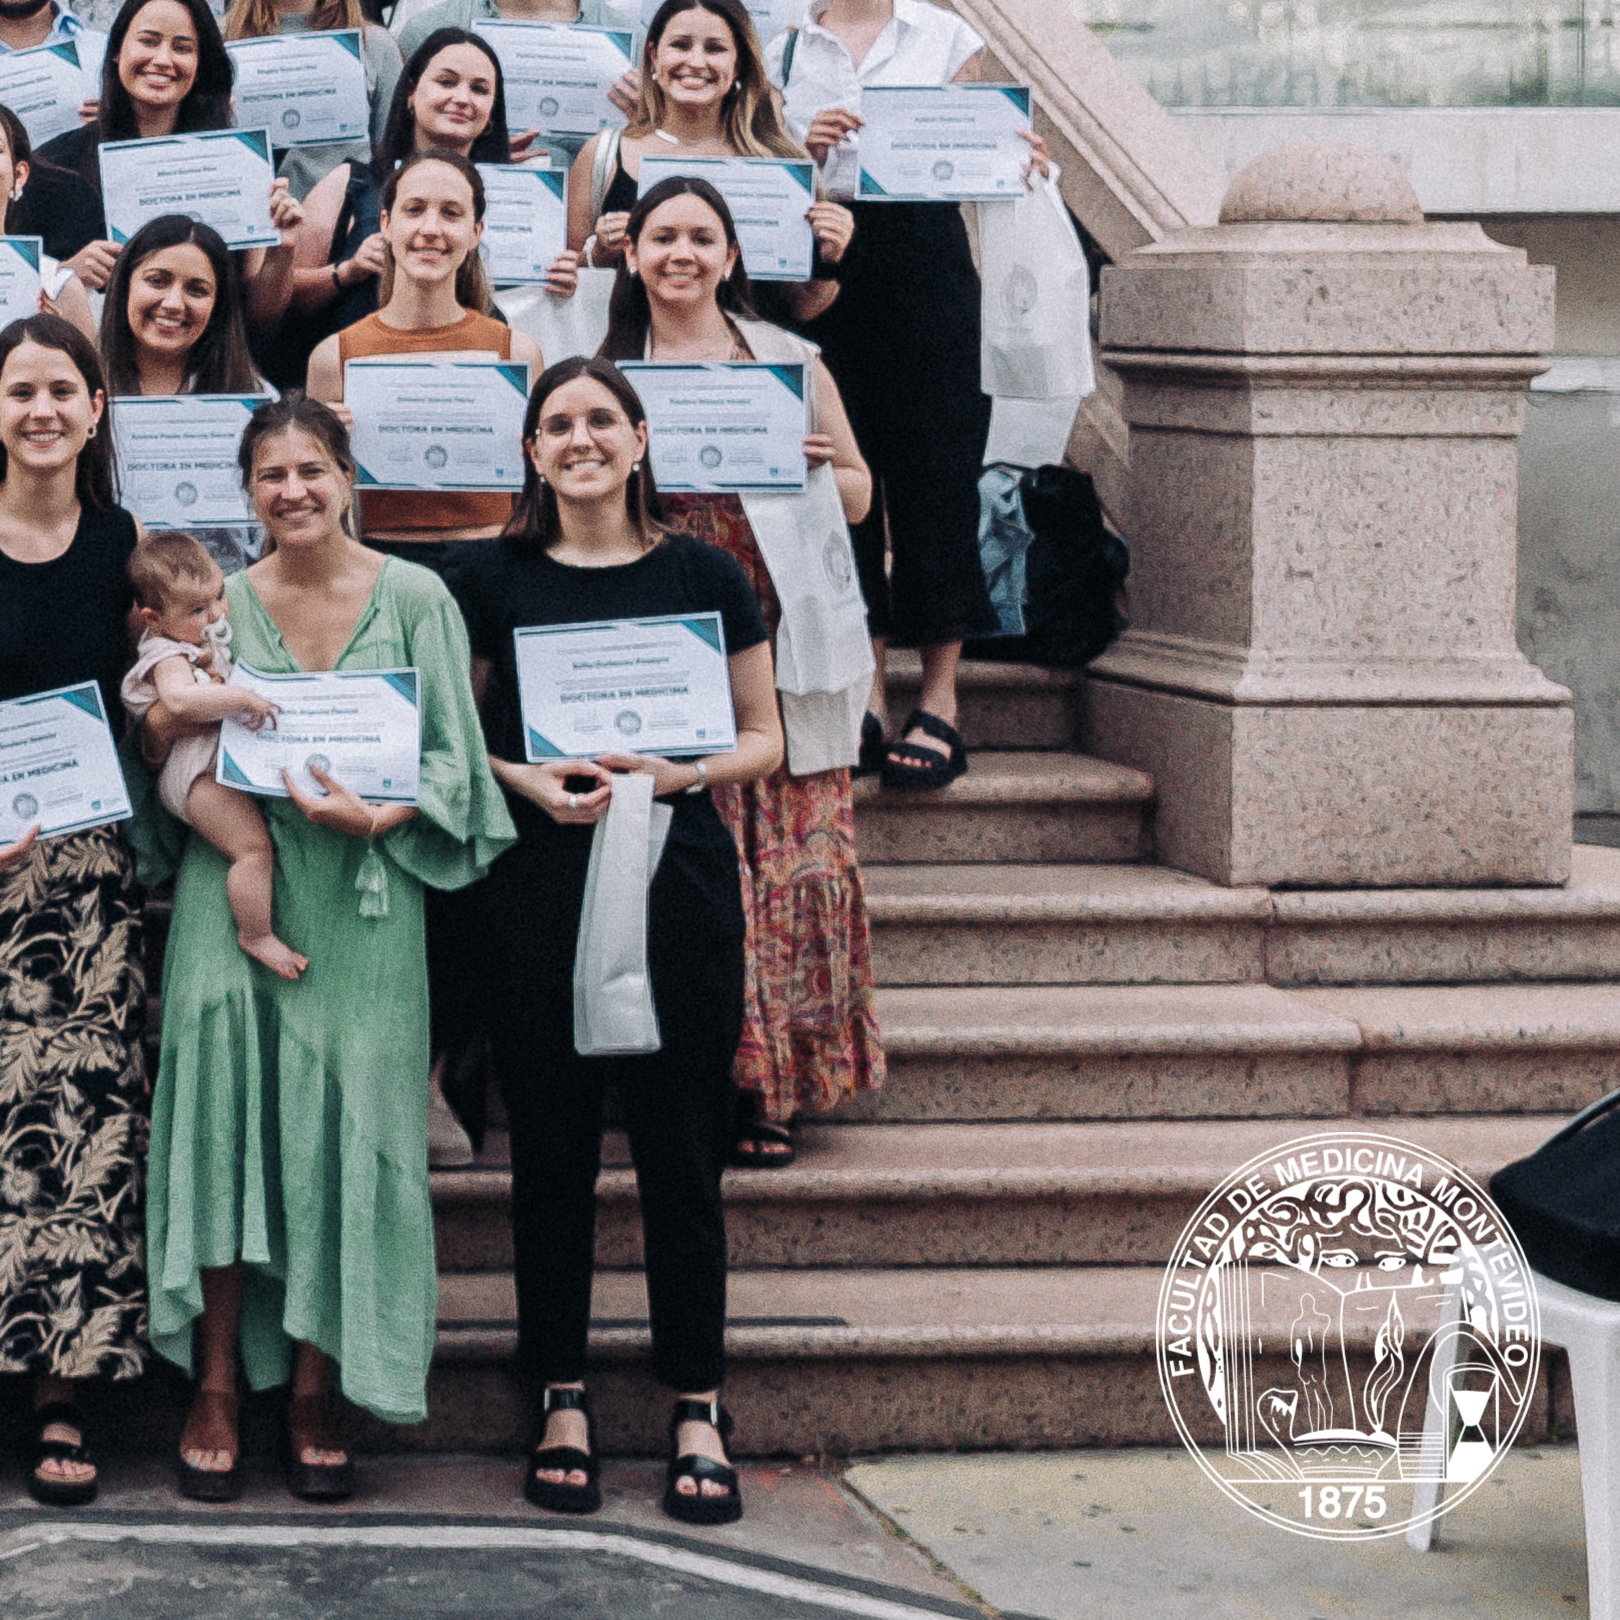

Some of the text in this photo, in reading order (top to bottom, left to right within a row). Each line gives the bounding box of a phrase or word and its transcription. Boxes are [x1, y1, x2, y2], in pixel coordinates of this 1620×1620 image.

[198, 188, 242, 200] MEDICINA
[635, 685, 690, 699] MEDICINA
[11, 770, 26, 782] EN
[27, 758, 80, 779] MEDICINA
